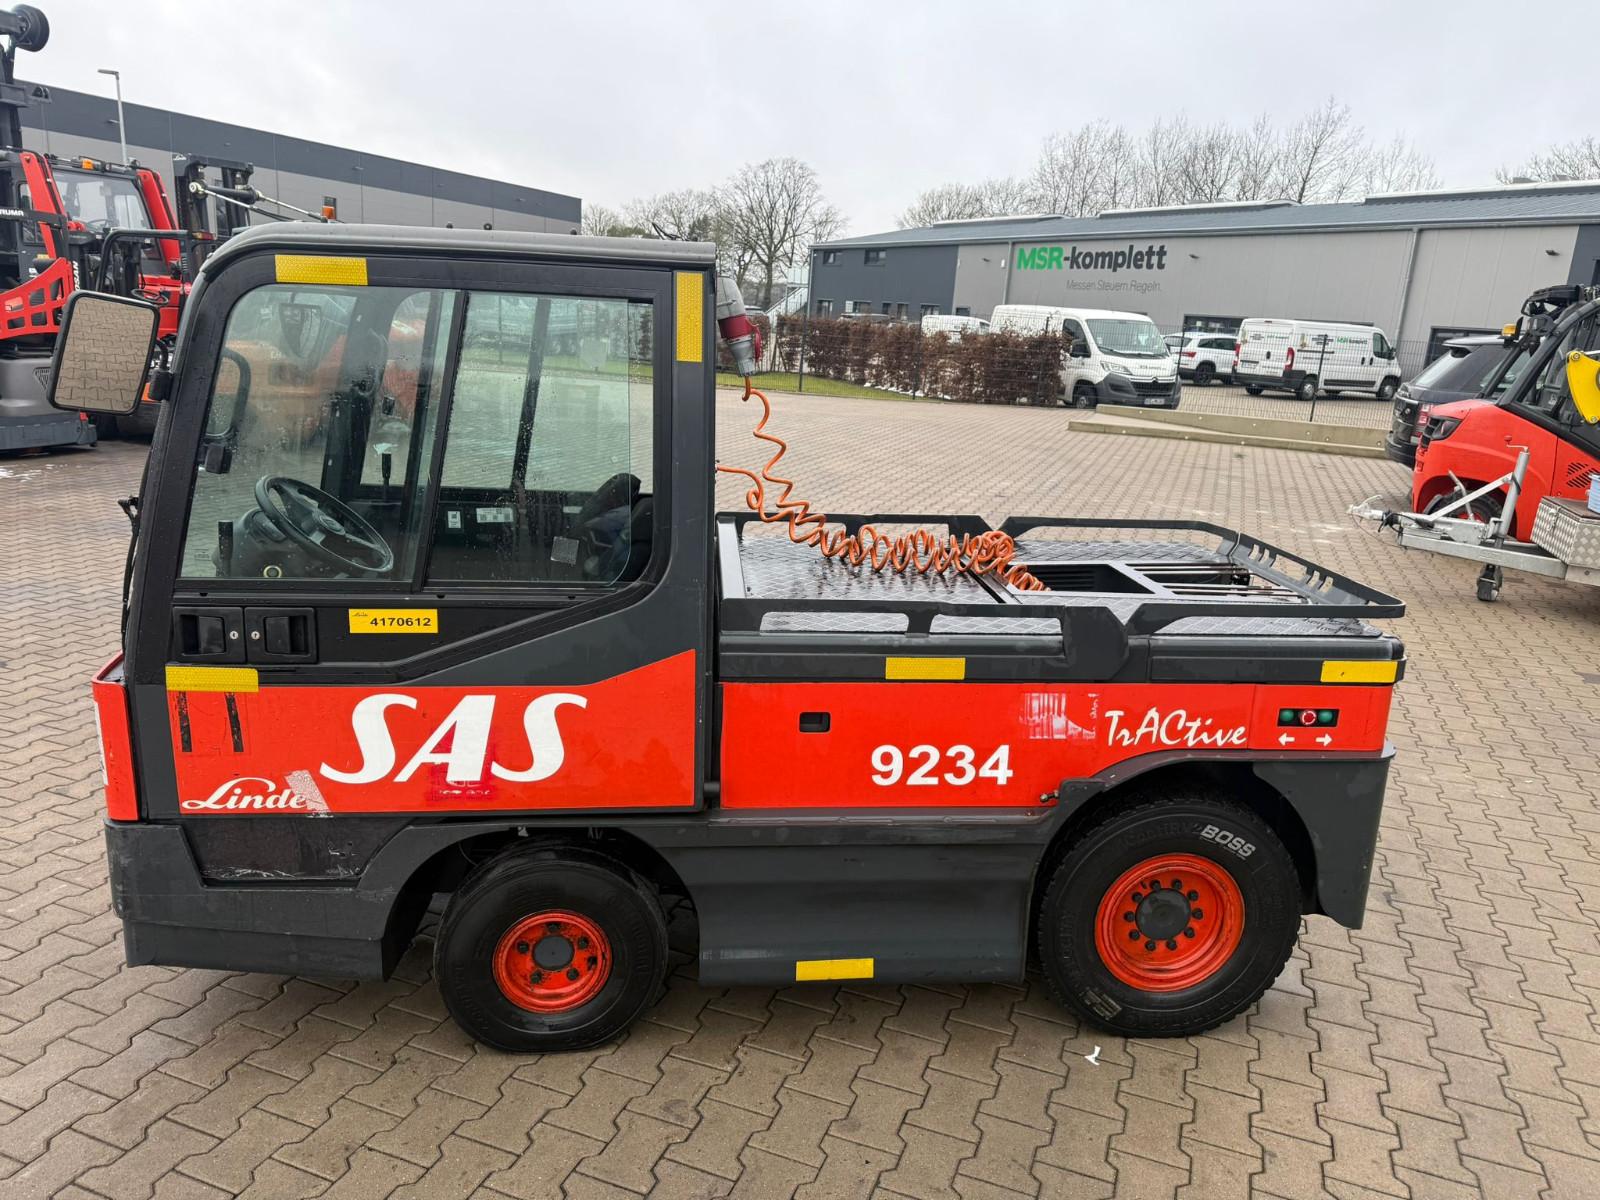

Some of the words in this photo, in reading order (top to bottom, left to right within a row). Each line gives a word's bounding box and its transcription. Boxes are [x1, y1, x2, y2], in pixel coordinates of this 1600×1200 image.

[1017, 244, 1167, 272] MSR-komplett
[370, 617, 432, 627] 4170612
[319, 692, 588, 785] SAS
[1105, 707, 1248, 747] TrACtive
[871, 744, 1013, 786] 9234
[182, 777, 307, 810] Linde
[1200, 824, 1257, 857] BOSS
